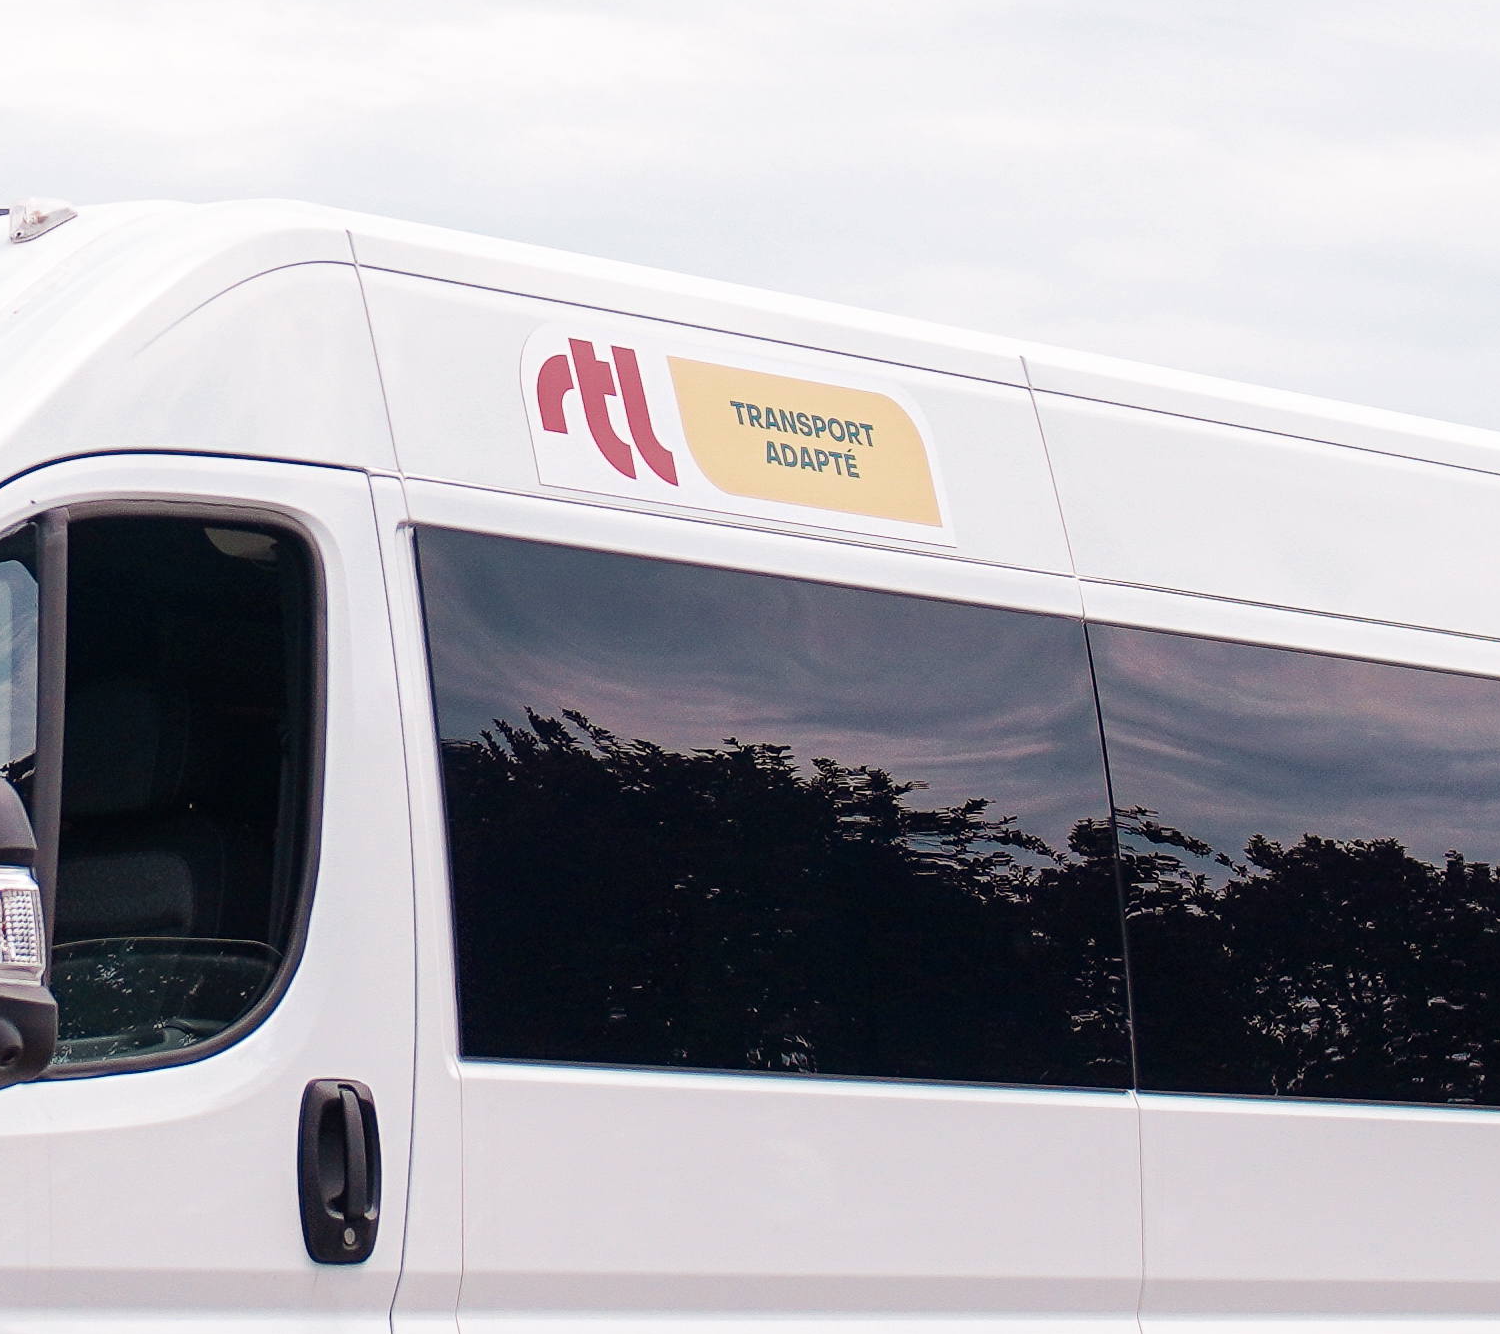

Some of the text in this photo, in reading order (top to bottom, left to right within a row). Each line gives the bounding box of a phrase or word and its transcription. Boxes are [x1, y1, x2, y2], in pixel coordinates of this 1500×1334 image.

[536, 337, 679, 487] rtl
[730, 400, 874, 448] TRANSPORT
[766, 440, 861, 479] ADAPTÉ
